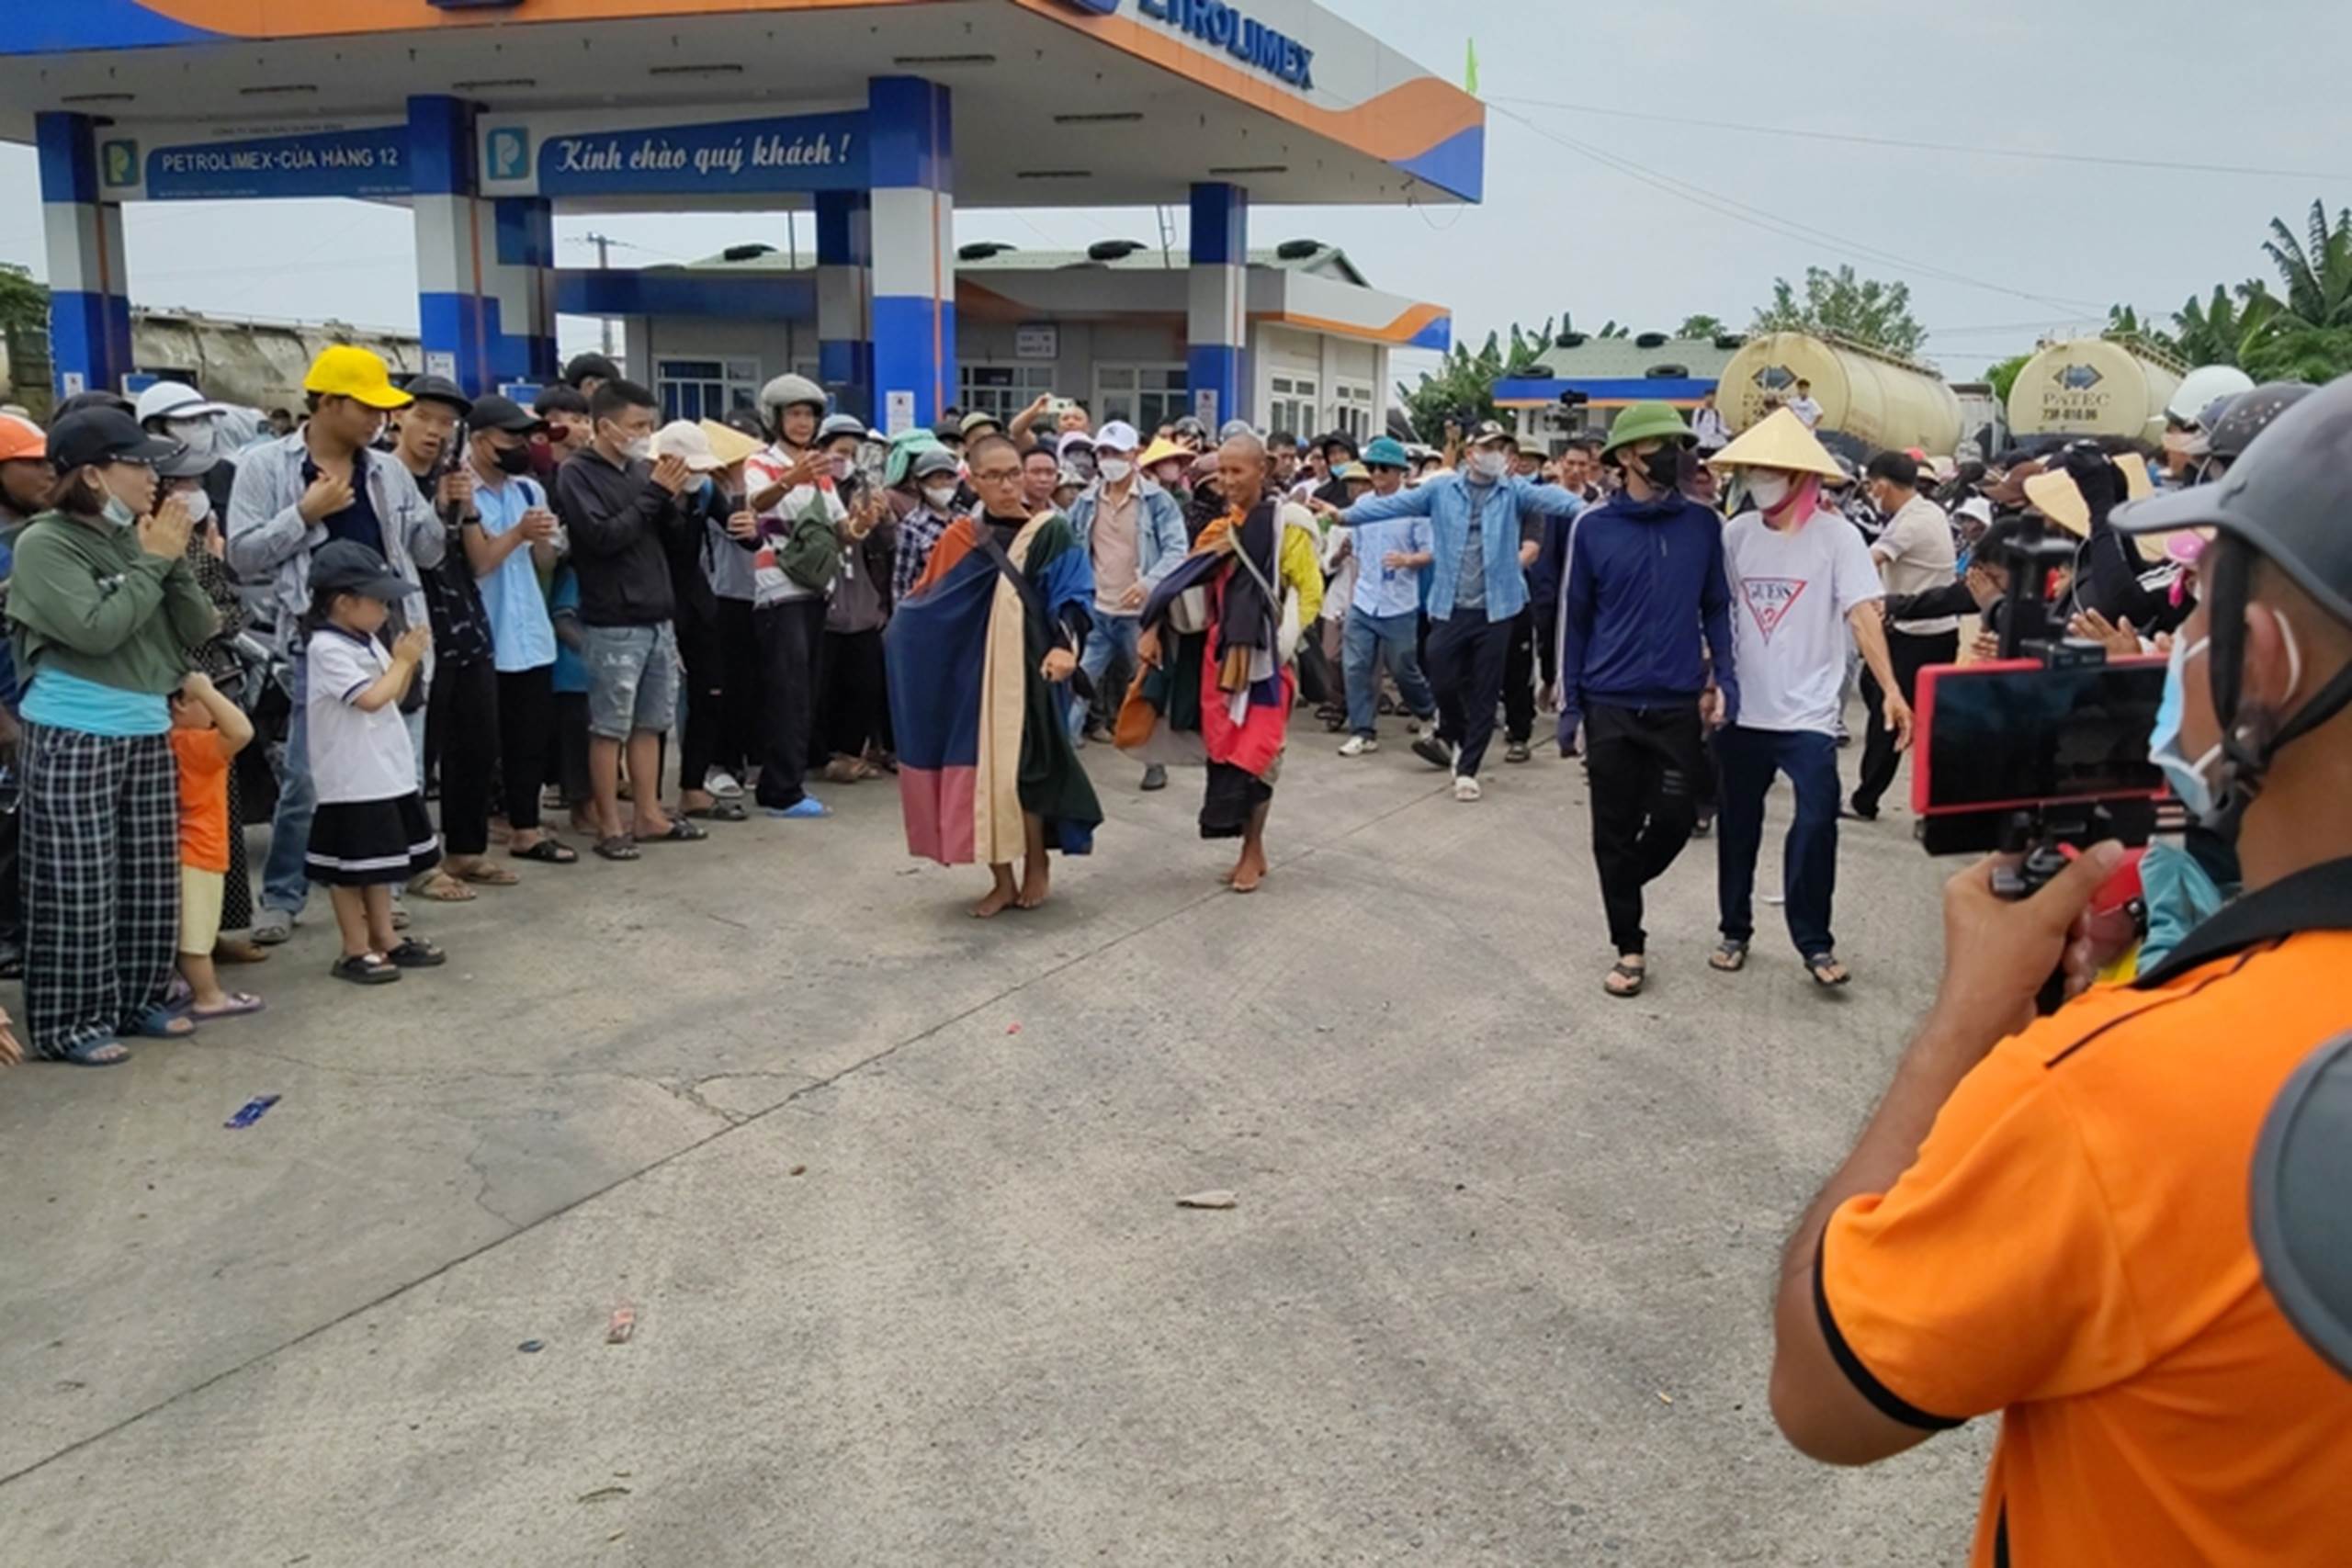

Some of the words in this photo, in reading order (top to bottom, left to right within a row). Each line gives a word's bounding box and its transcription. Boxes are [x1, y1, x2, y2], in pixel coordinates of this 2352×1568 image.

[322, 144, 374, 168] HÀNG
[379, 147, 399, 167] 12
[555, 139, 623, 172] Kính
[629, 137, 687, 169] chào
[694, 135, 744, 175] quý
[752, 134, 831, 167] khách
